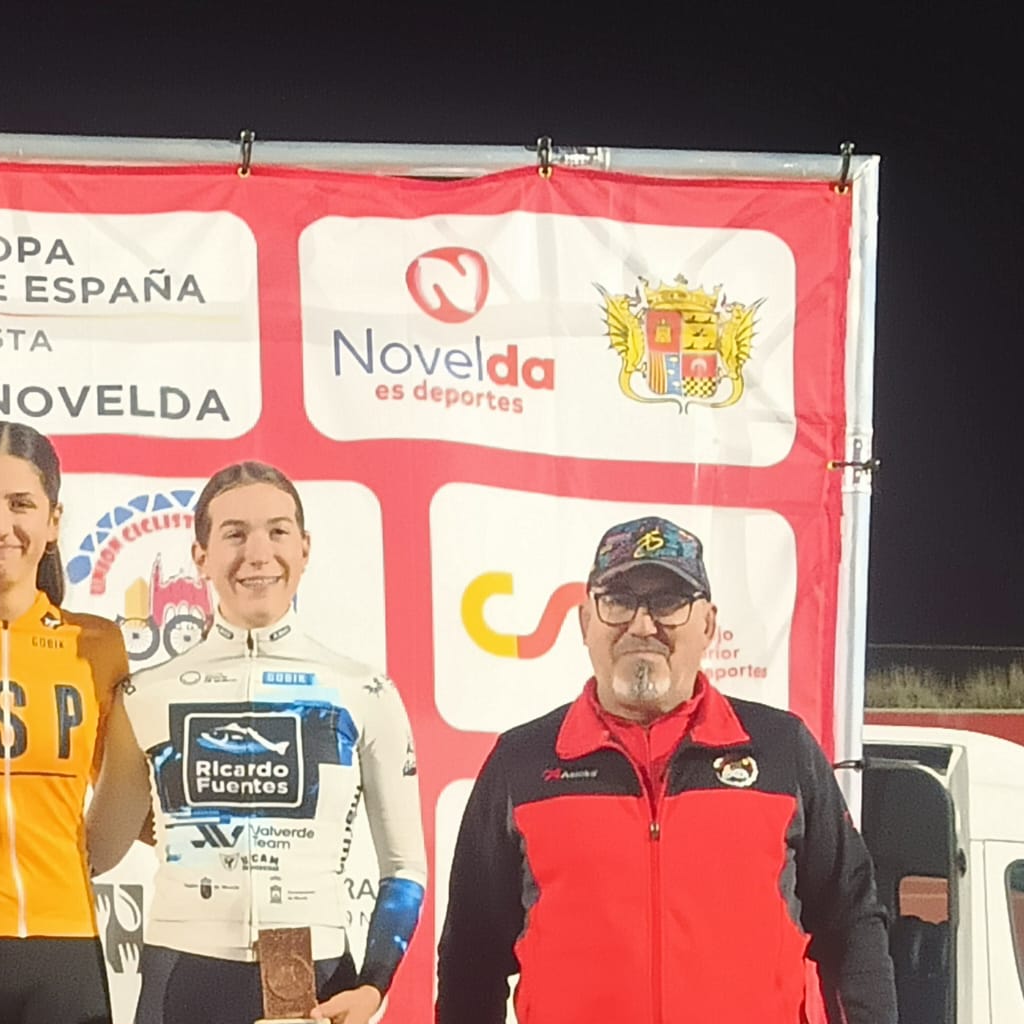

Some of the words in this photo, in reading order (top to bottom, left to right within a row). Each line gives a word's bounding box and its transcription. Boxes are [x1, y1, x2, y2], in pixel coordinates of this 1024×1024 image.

[25, 269, 206, 304] ESPAÑA
[332, 327, 555, 391] Novelda
[376, 384, 404, 401] es
[413, 380, 523, 414] deportes
[195, 760, 289, 777] Ricardo
[195, 778, 289, 795] Fuentes
